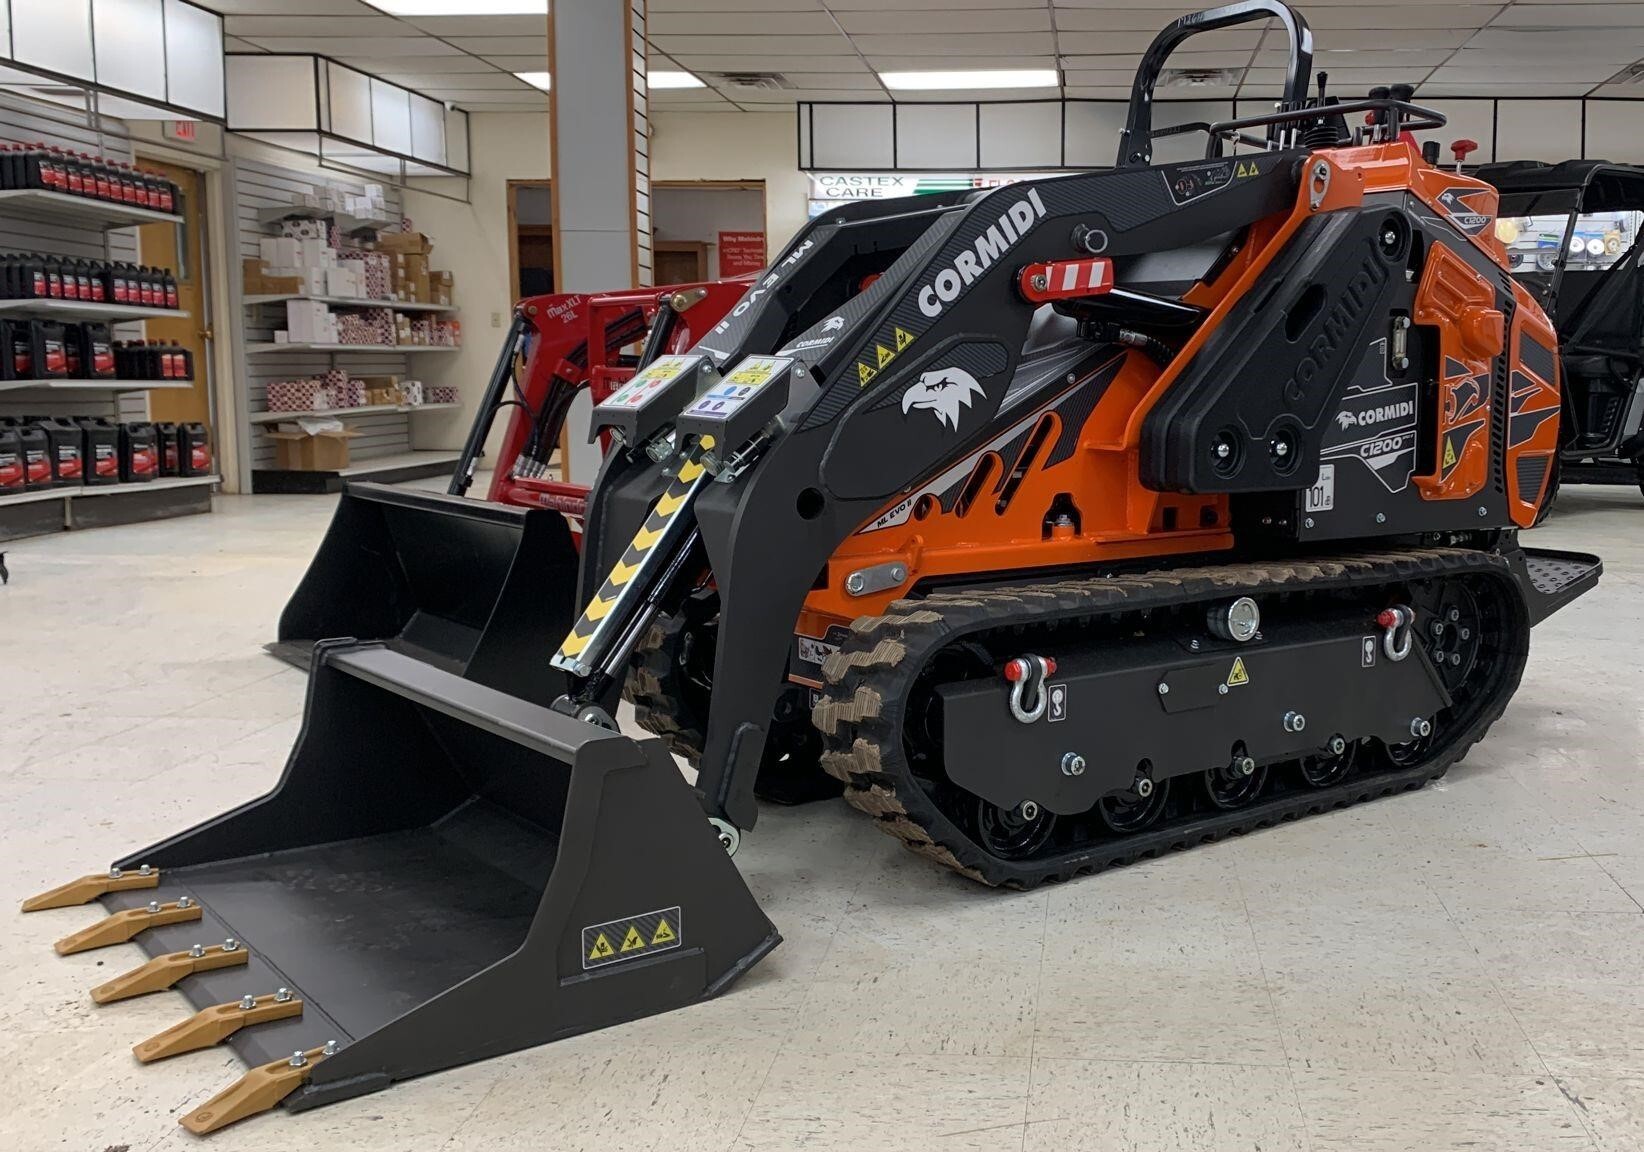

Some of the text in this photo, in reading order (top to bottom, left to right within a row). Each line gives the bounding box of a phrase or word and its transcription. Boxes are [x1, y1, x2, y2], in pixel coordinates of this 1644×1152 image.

[820, 176, 904, 187] CASTEX
[826, 187, 883, 198] CARE
[781, 240, 814, 268] ML
[918, 187, 1047, 317] CORMIDI
[733, 273, 780, 317] EVO
[1358, 401, 1414, 426] CORMIDI
[1360, 437, 1402, 457] C1200
[1309, 485, 1324, 508] 101
[877, 517, 888, 528] ML
[889, 504, 906, 519] EVO
